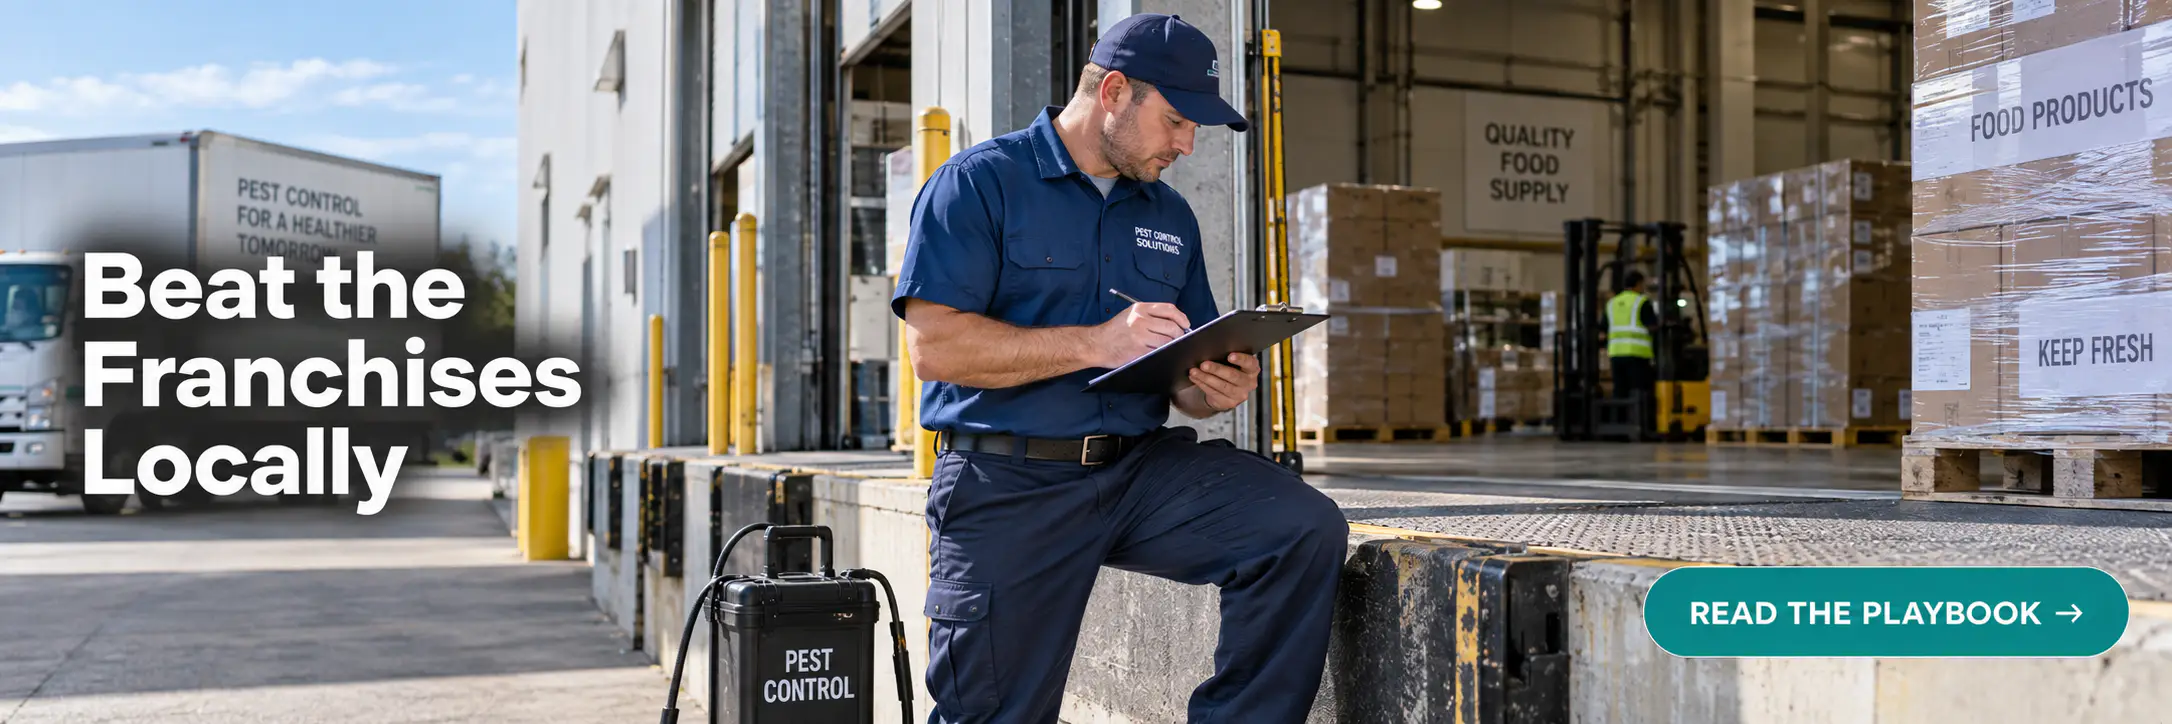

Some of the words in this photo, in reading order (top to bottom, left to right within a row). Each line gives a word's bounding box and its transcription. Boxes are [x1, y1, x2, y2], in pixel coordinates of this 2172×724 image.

[1971, 106, 2025, 142] FOOD
[2032, 77, 2154, 130] PRODUCTS
[1485, 121, 1575, 149] QUALITY
[1500, 151, 1560, 175] FOOD
[238, 178, 280, 203] PEST
[286, 186, 363, 217] CONTROL
[1489, 178, 1570, 204] SUPPLY
[237, 205, 271, 229] FOR
[276, 212, 288, 231] A
[293, 215, 378, 244] HEALTHIER
[1134, 226, 1152, 239] PEST
[2038, 337, 2084, 367] KEEP
[2091, 332, 2153, 364] FRESH
[785, 648, 834, 673] PEST
[763, 676, 855, 703] CONTROL
